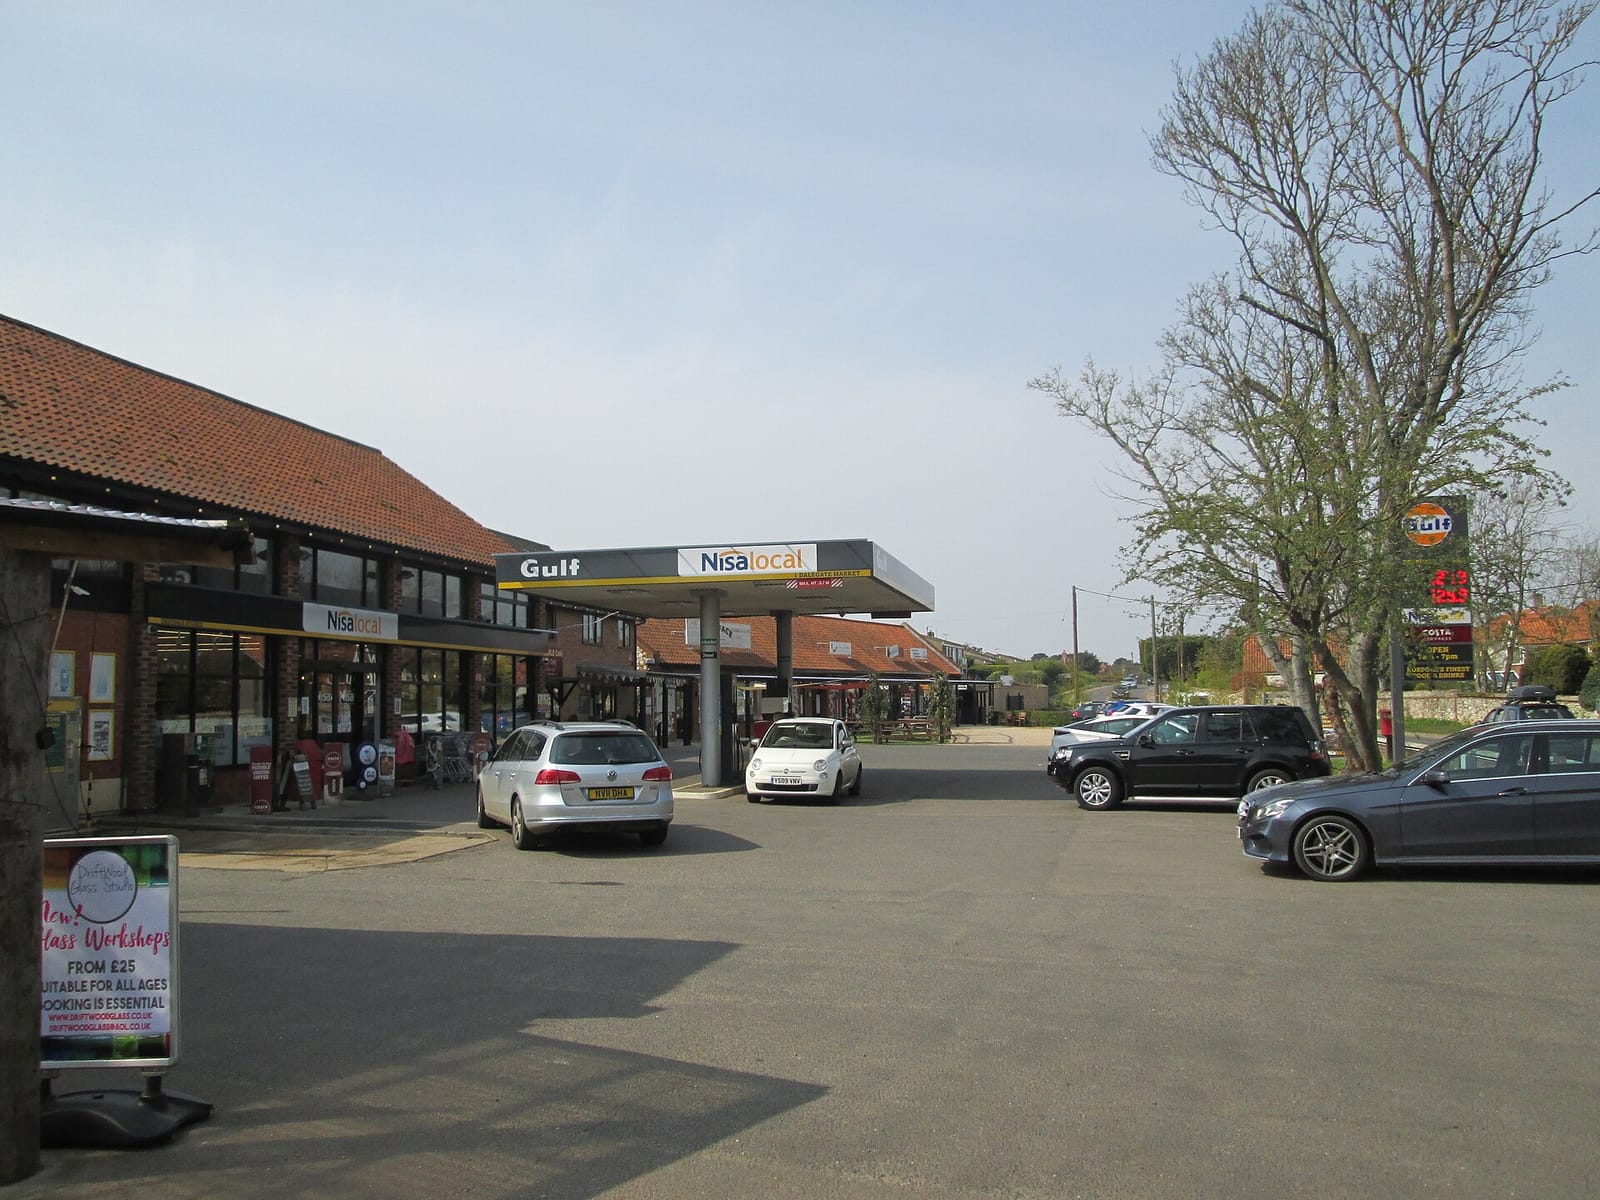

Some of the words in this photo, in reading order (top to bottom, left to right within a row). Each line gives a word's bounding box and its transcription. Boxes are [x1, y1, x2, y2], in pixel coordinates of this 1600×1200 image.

[520, 558, 580, 577] Gulf
[42, 927, 75, 951] lass
[85, 923, 170, 955] Workshops
[68, 961, 106, 974] FROM
[111, 959, 136, 973] £25
[42, 981, 88, 993] UITABLE
[90, 979, 113, 991] FOR
[115, 979, 136, 991] ALL
[138, 978, 168, 990] AGES
[42, 999, 91, 1011] OOKING
[94, 999, 105, 1010] IS
[106, 996, 165, 1009] ESSENTIAL
